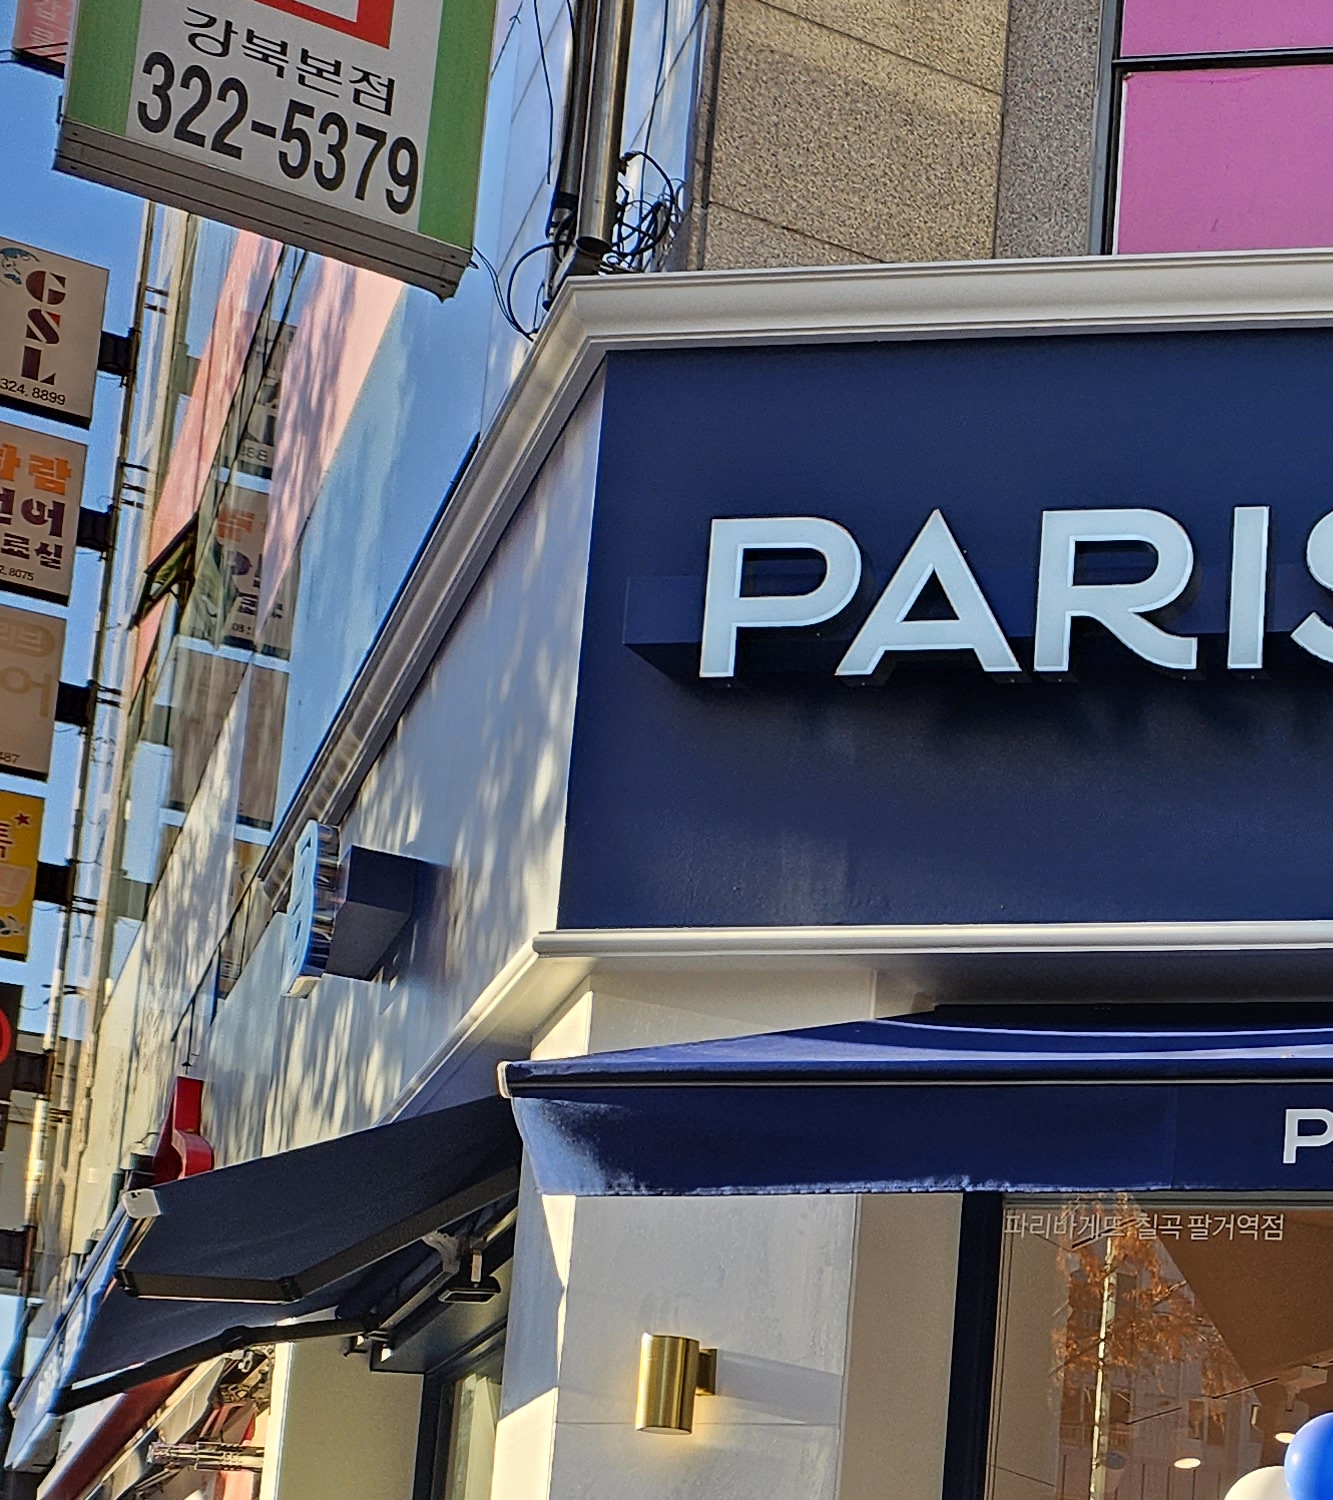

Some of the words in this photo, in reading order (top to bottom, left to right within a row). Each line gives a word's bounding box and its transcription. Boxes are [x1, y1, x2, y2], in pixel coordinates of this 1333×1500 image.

[181, 7, 396, 117] 강북본점
[136, 50, 420, 216] 322-5379
[21, 269, 67, 386] GSL
[1003, 1213, 1126, 1241] 파리바게뜨
